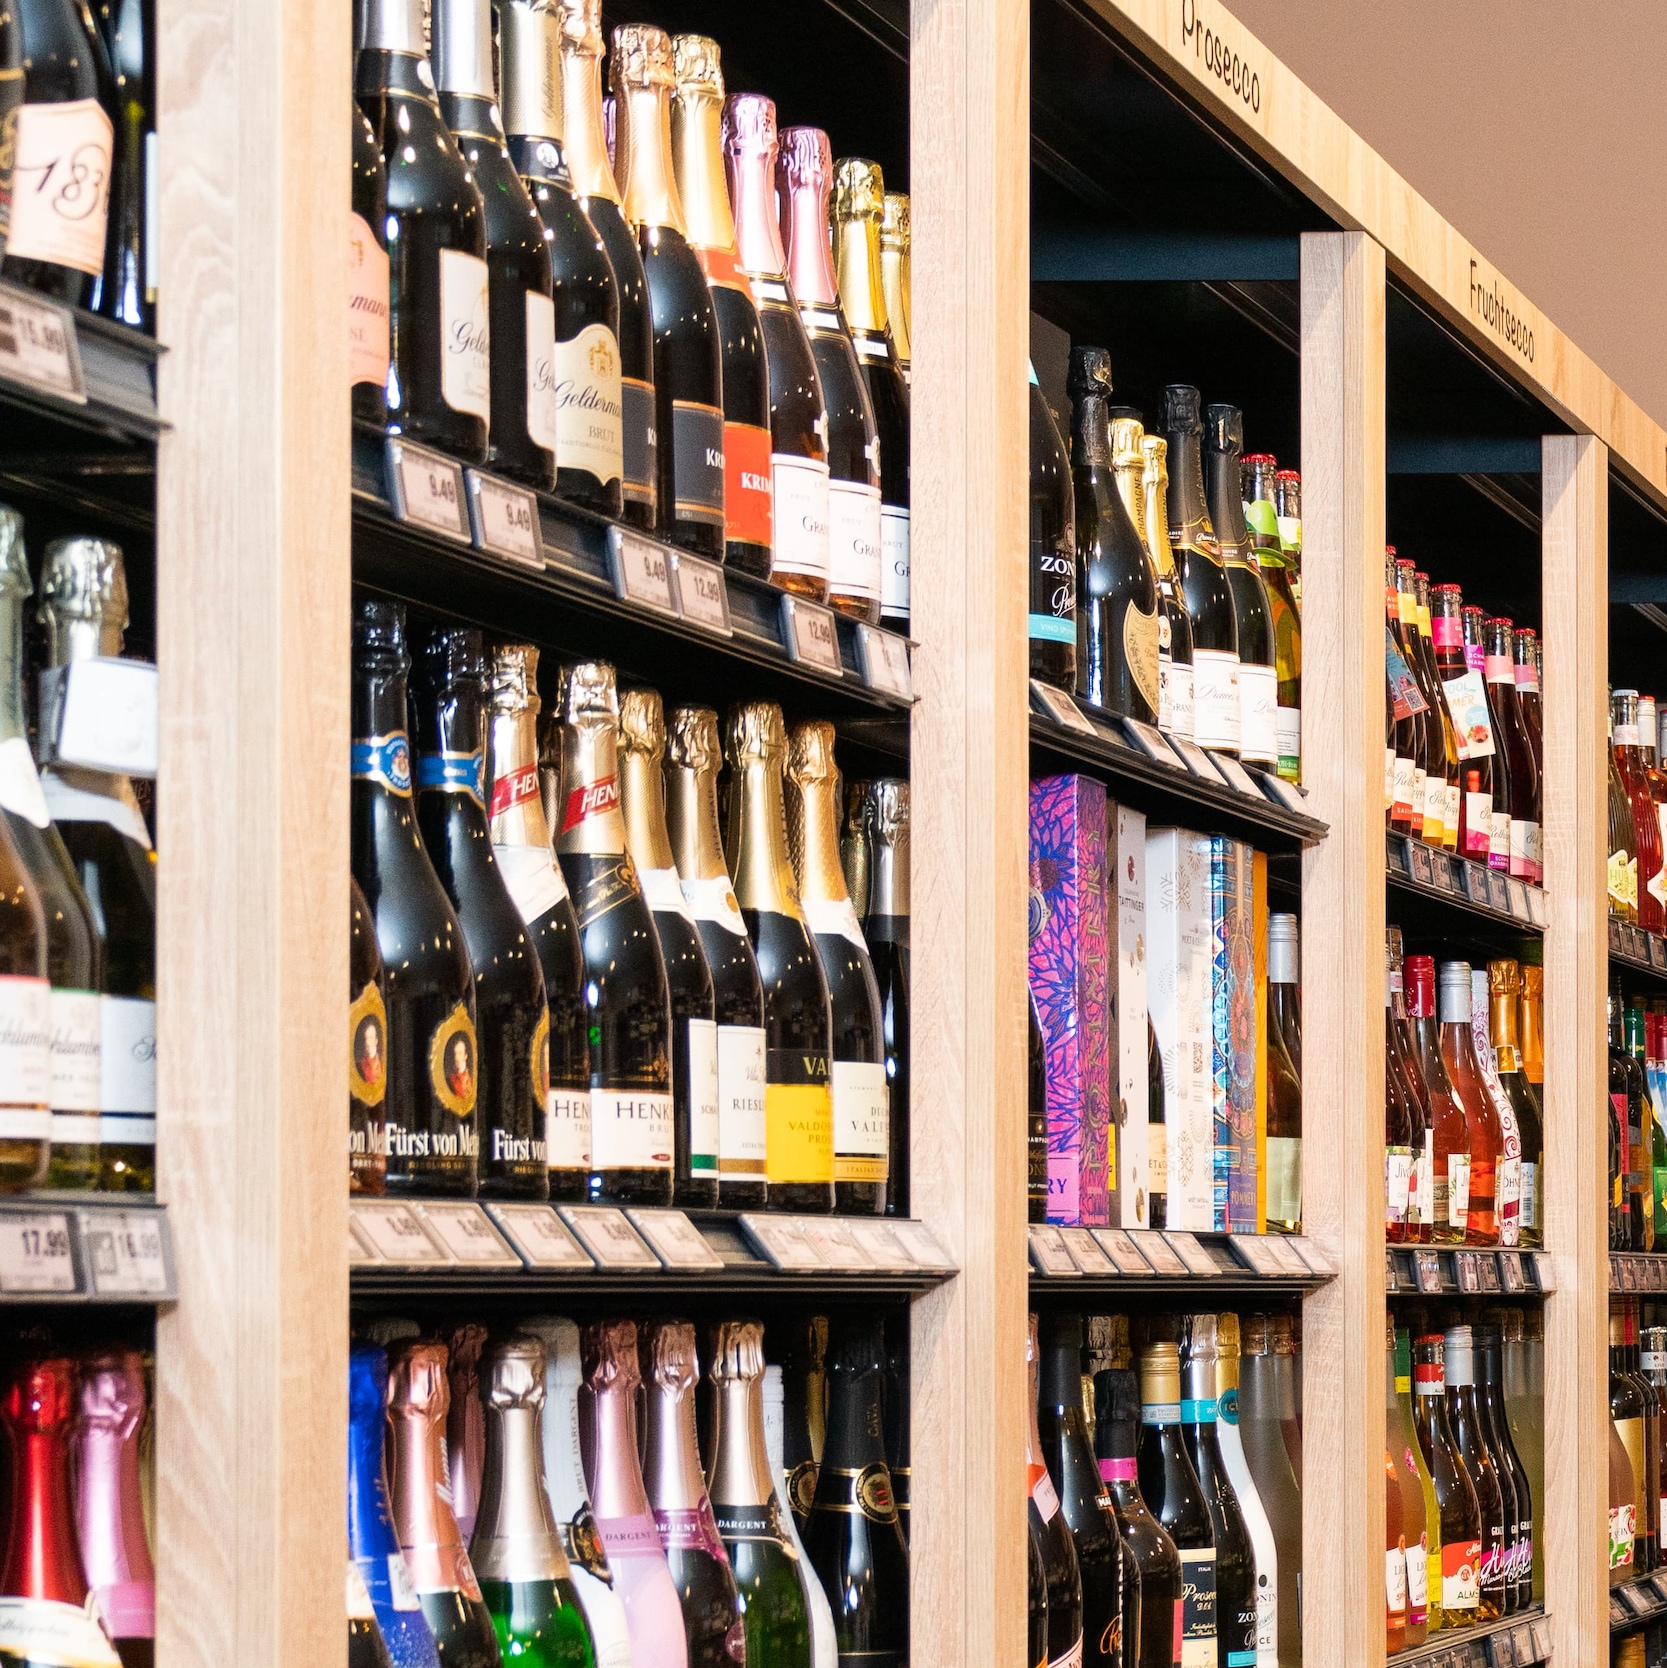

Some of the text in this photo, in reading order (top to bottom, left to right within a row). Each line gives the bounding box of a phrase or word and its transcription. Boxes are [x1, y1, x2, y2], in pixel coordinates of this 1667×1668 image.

[1182, 0, 1261, 114] Prosecco
[1469, 257, 1535, 364] Fruchtsecco
[588, 426, 615, 439] BRUT
[694, 577, 719, 602] 12.99
[808, 621, 831, 644] 12.99
[385, 1122, 458, 1156] Fürst von
[493, 1128, 529, 1161] Fürst
[605, 1530, 652, 1543] DARGENT
[718, 1518, 767, 1531] DARGENT
